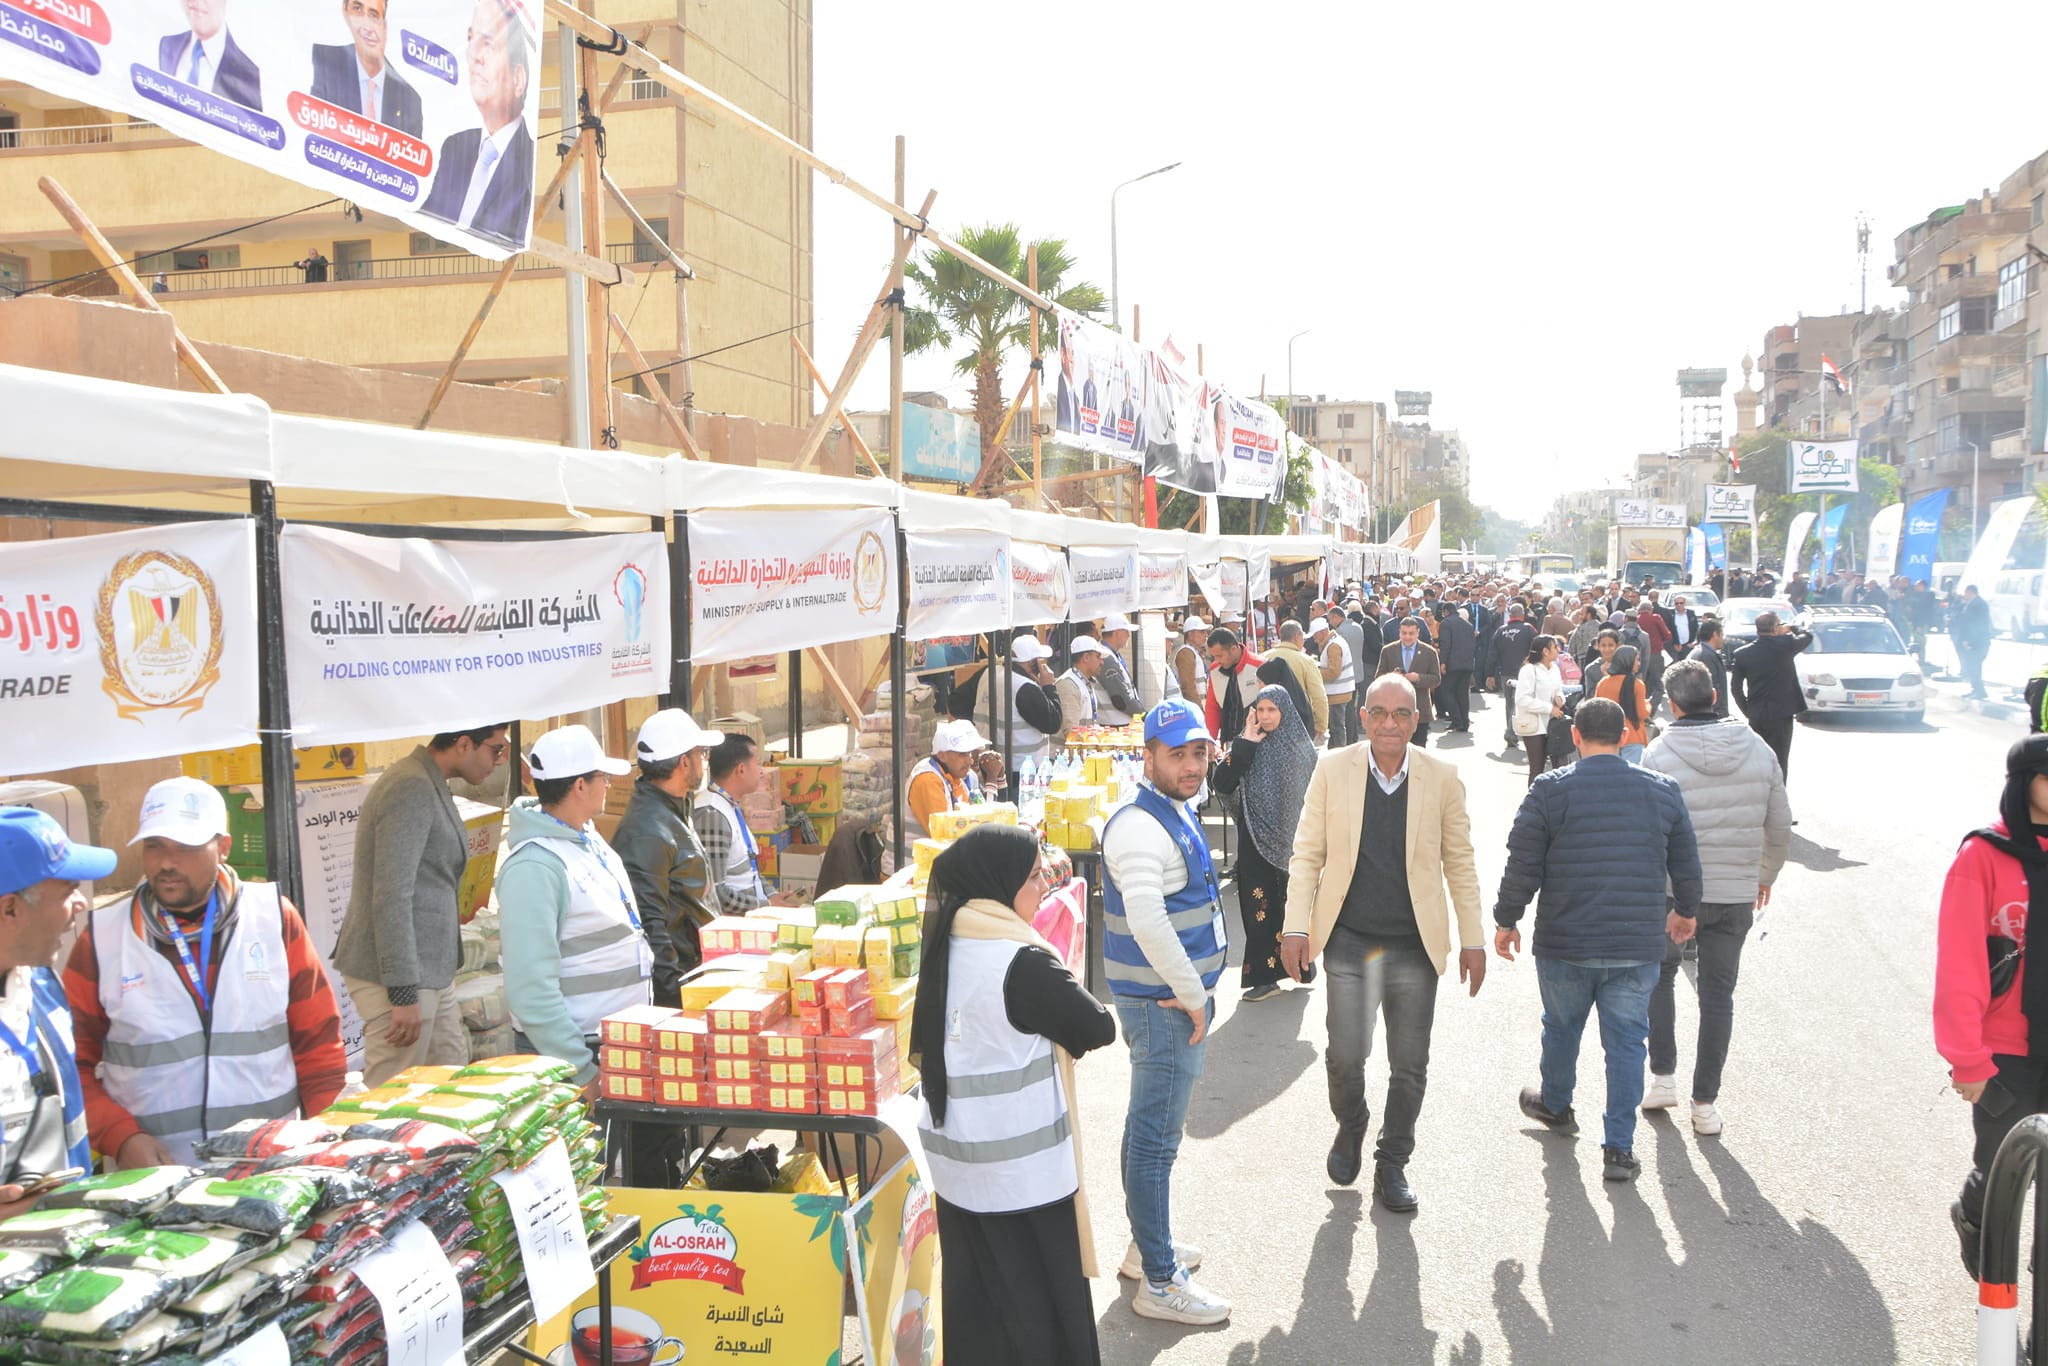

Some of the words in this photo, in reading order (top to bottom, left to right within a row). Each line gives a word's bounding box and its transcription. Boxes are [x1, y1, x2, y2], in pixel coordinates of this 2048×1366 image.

[407, 38, 454, 80] بالسادة
[203, 102, 239, 127] مستقبل
[297, 101, 339, 132] فاروق
[340, 123, 380, 146] شريف
[339, 153, 367, 175] التجارة
[386, 139, 428, 168] الدكتور
[372, 168, 402, 189] التموين
[401, 179, 416, 198] وزير
[697, 559, 748, 593] الداخلية
[751, 556, 786, 589] التجارة
[829, 552, 851, 580] وزارة
[387, 602, 476, 635] للصناعات
[474, 599, 533, 638] القابضة
[540, 589, 601, 634] الشركة
[703, 604, 745, 620] MINISTRY
[756, 599, 783, 612] SUPPLY
[786, 599, 791, 609] &
[310, 599, 383, 645] الغذائية
[323, 662, 390, 680] HOLDING
[392, 658, 454, 676] COMPANY
[456, 655, 483, 672] FOR
[487, 650, 524, 669] FOOD
[527, 642, 603, 664] INDUSTRIES
[0, 675, 71, 698] RADE
[305, 810, 337, 828] الواحد
[700, 1222, 719, 1235] Tea
[653, 1234, 726, 1251] AL-OSRAH
[648, 1258, 671, 1273] best
[673, 1257, 710, 1278] quality
[712, 1262, 730, 1276] tea
[706, 1303, 749, 1323] الأسرة
[715, 1336, 771, 1355] السعيدة
